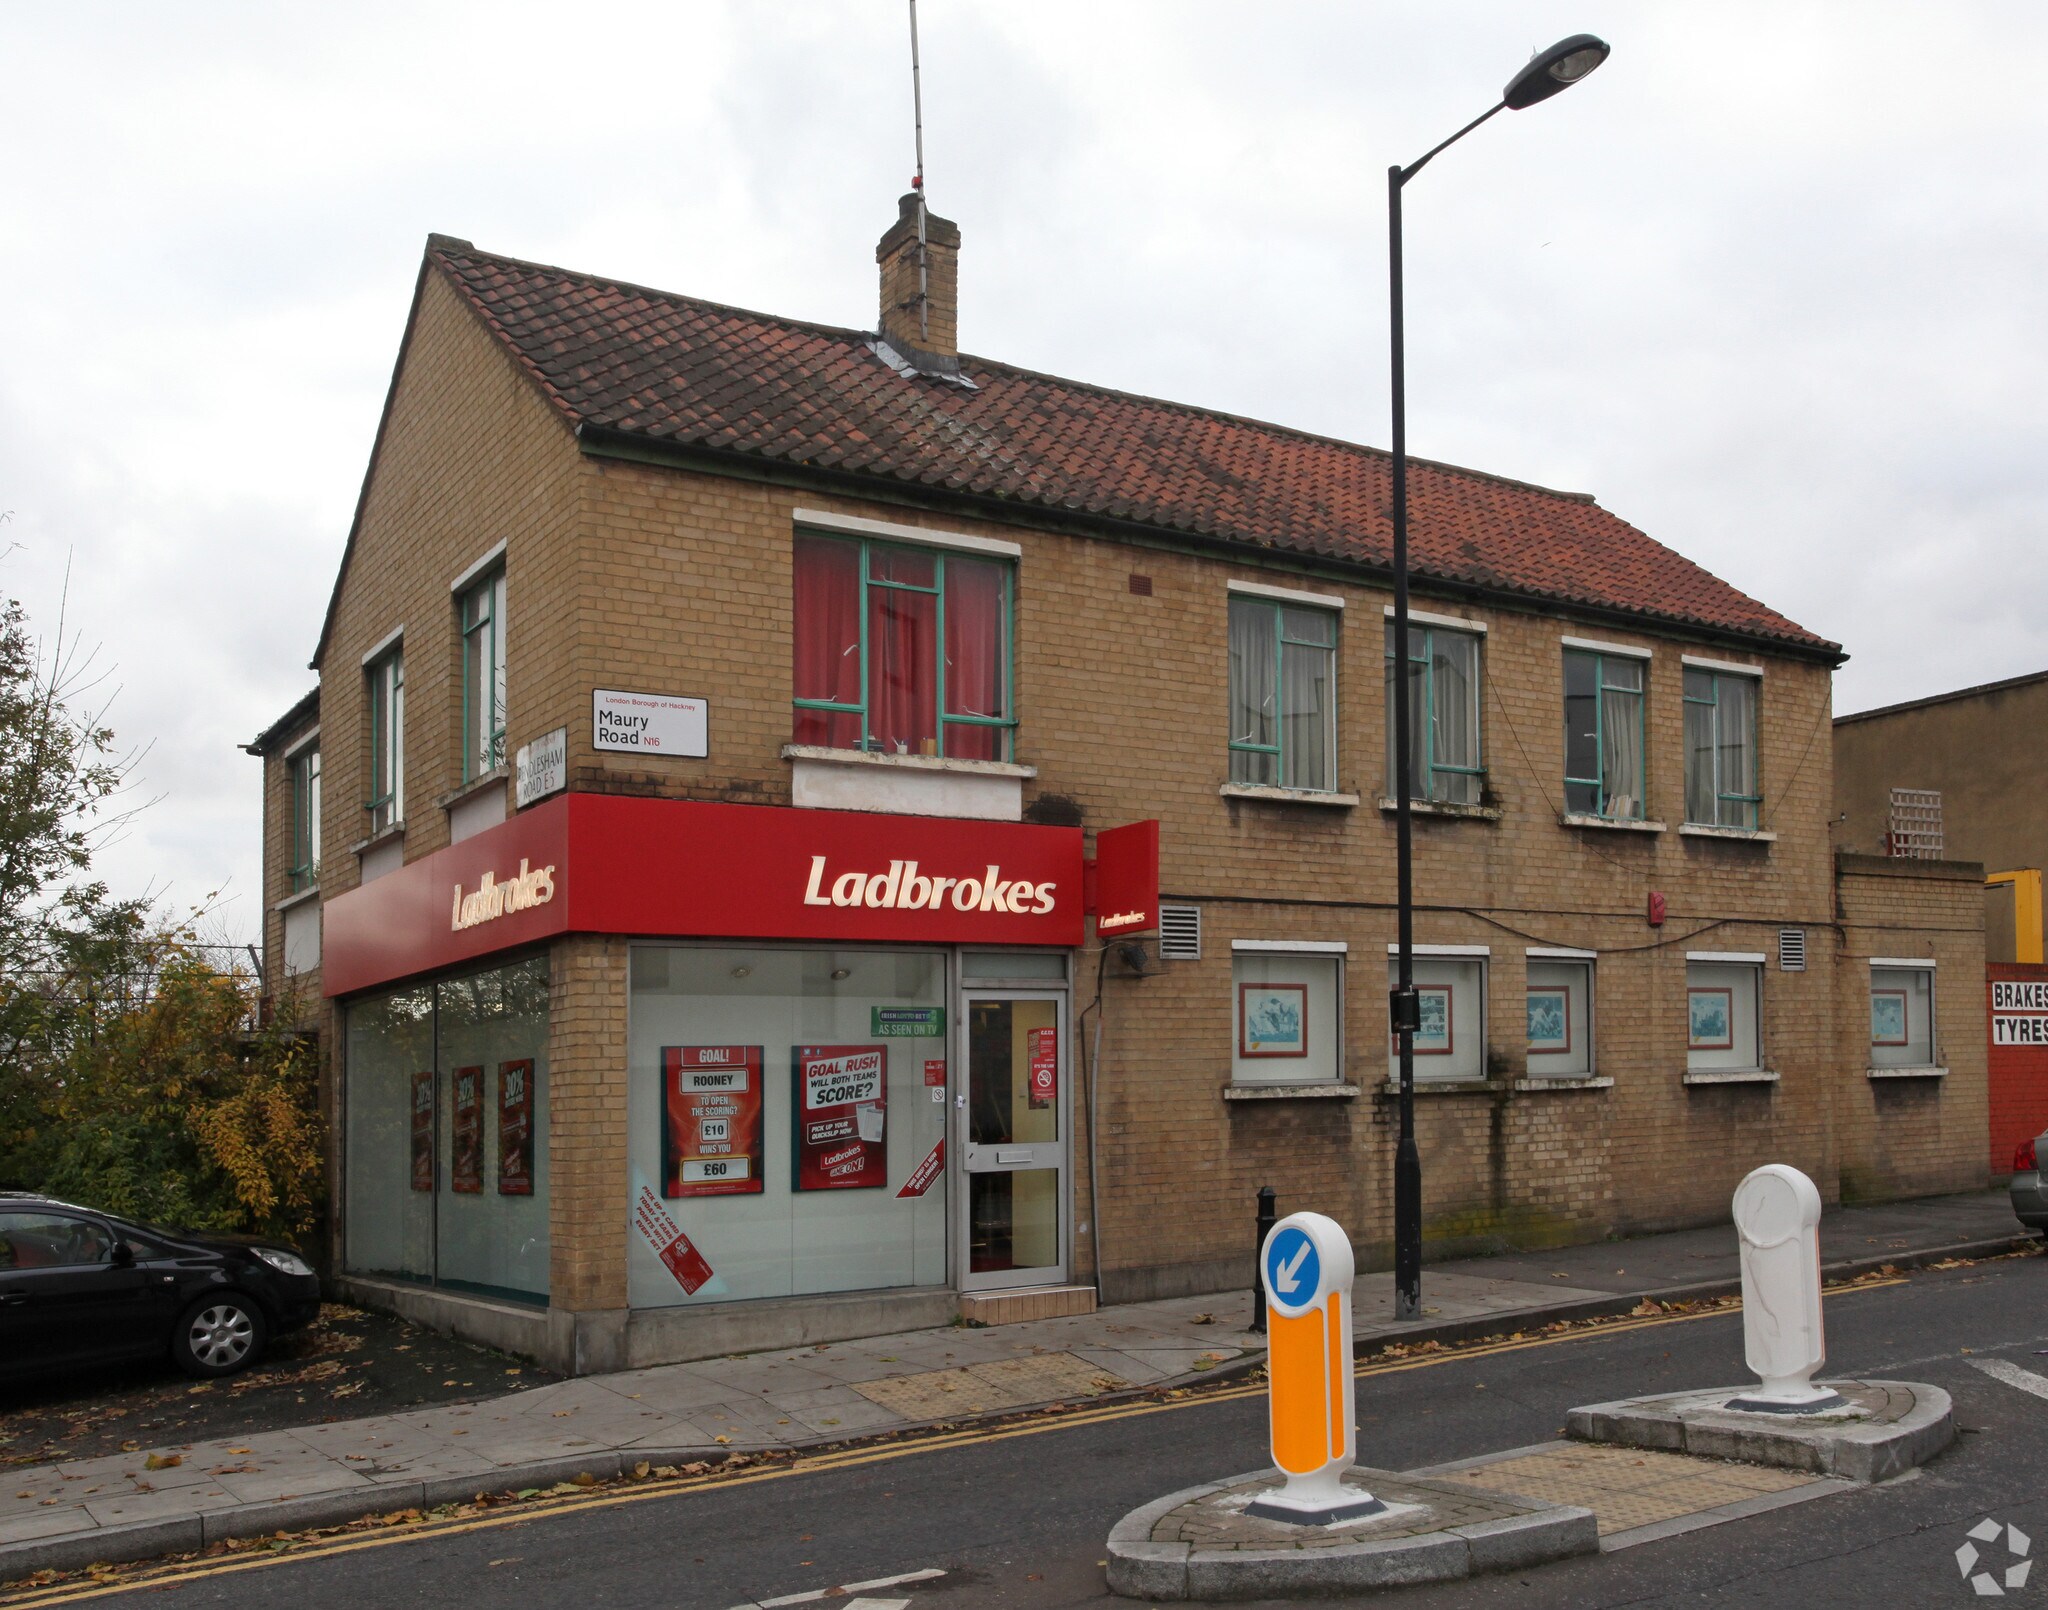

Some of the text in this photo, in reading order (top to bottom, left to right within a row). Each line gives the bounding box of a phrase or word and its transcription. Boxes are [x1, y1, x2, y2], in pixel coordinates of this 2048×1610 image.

[606, 697, 630, 705] London
[632, 699, 658, 708] Borough
[669, 702, 695, 711] Hackney
[599, 710, 649, 731] Maury
[599, 727, 660, 746] Road N16
[524, 770, 554, 799] ROAD E5
[804, 855, 1056, 914] Ladbrokes
[452, 858, 555, 931] Ladbrokes
[879, 1024, 937, 1034] AS SEEN ON TV
[699, 1049, 730, 1063] GOAL!
[809, 1056, 879, 1078] GOAL RUSH
[694, 1075, 733, 1086] ROONEY
[811, 1071, 877, 1088] WILL BOTH TEAMS
[701, 1096, 728, 1105] TO OPEN
[816, 1082, 873, 1105] SCORE?
[692, 1106, 738, 1116] THE SCORING?
[704, 1125, 724, 1135] £10
[811, 1130, 839, 1140] QUICKSLIP
[700, 1144, 731, 1154] WINS YOU
[825, 1145, 861, 1165] Ladbrokes
[704, 1163, 727, 1176] £60
[640, 1196, 656, 1216] TODAY
[659, 1221, 674, 1240] EARN
[642, 1186, 655, 1201] PICK
[653, 1202, 663, 1211] UP
[665, 1217, 679, 1234] CARD
[636, 1207, 667, 1246] POINTS WITH
[636, 1220, 661, 1251] EVERY BET
